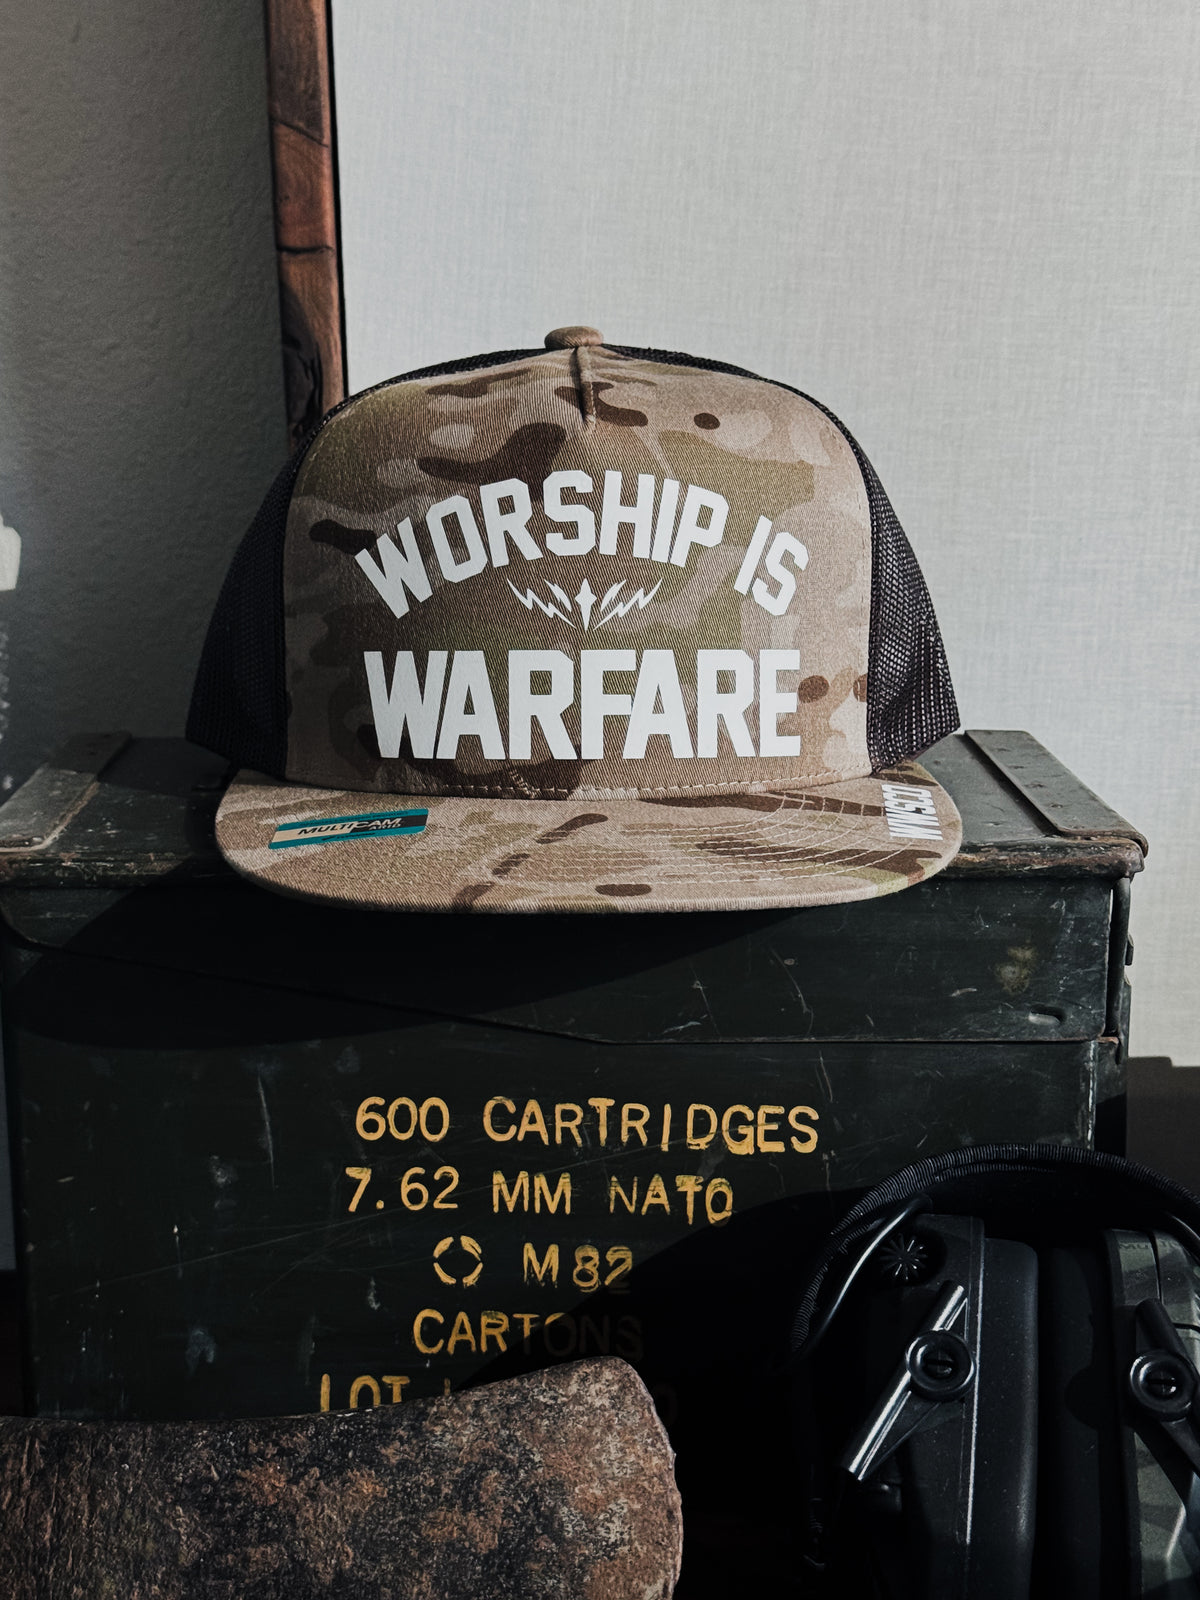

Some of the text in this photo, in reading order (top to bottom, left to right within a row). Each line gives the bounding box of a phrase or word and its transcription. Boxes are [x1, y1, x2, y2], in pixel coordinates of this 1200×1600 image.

[354, 470, 809, 620] WORSHIP IS
[364, 648, 801, 761] WARFARE
[298, 817, 402, 836] MULTICAM
[355, 1096, 819, 1156] 600 CARTRIDGES
[345, 1166, 734, 1227] 7.62 MM NATO
[412, 1309, 644, 1361] CARTONS
